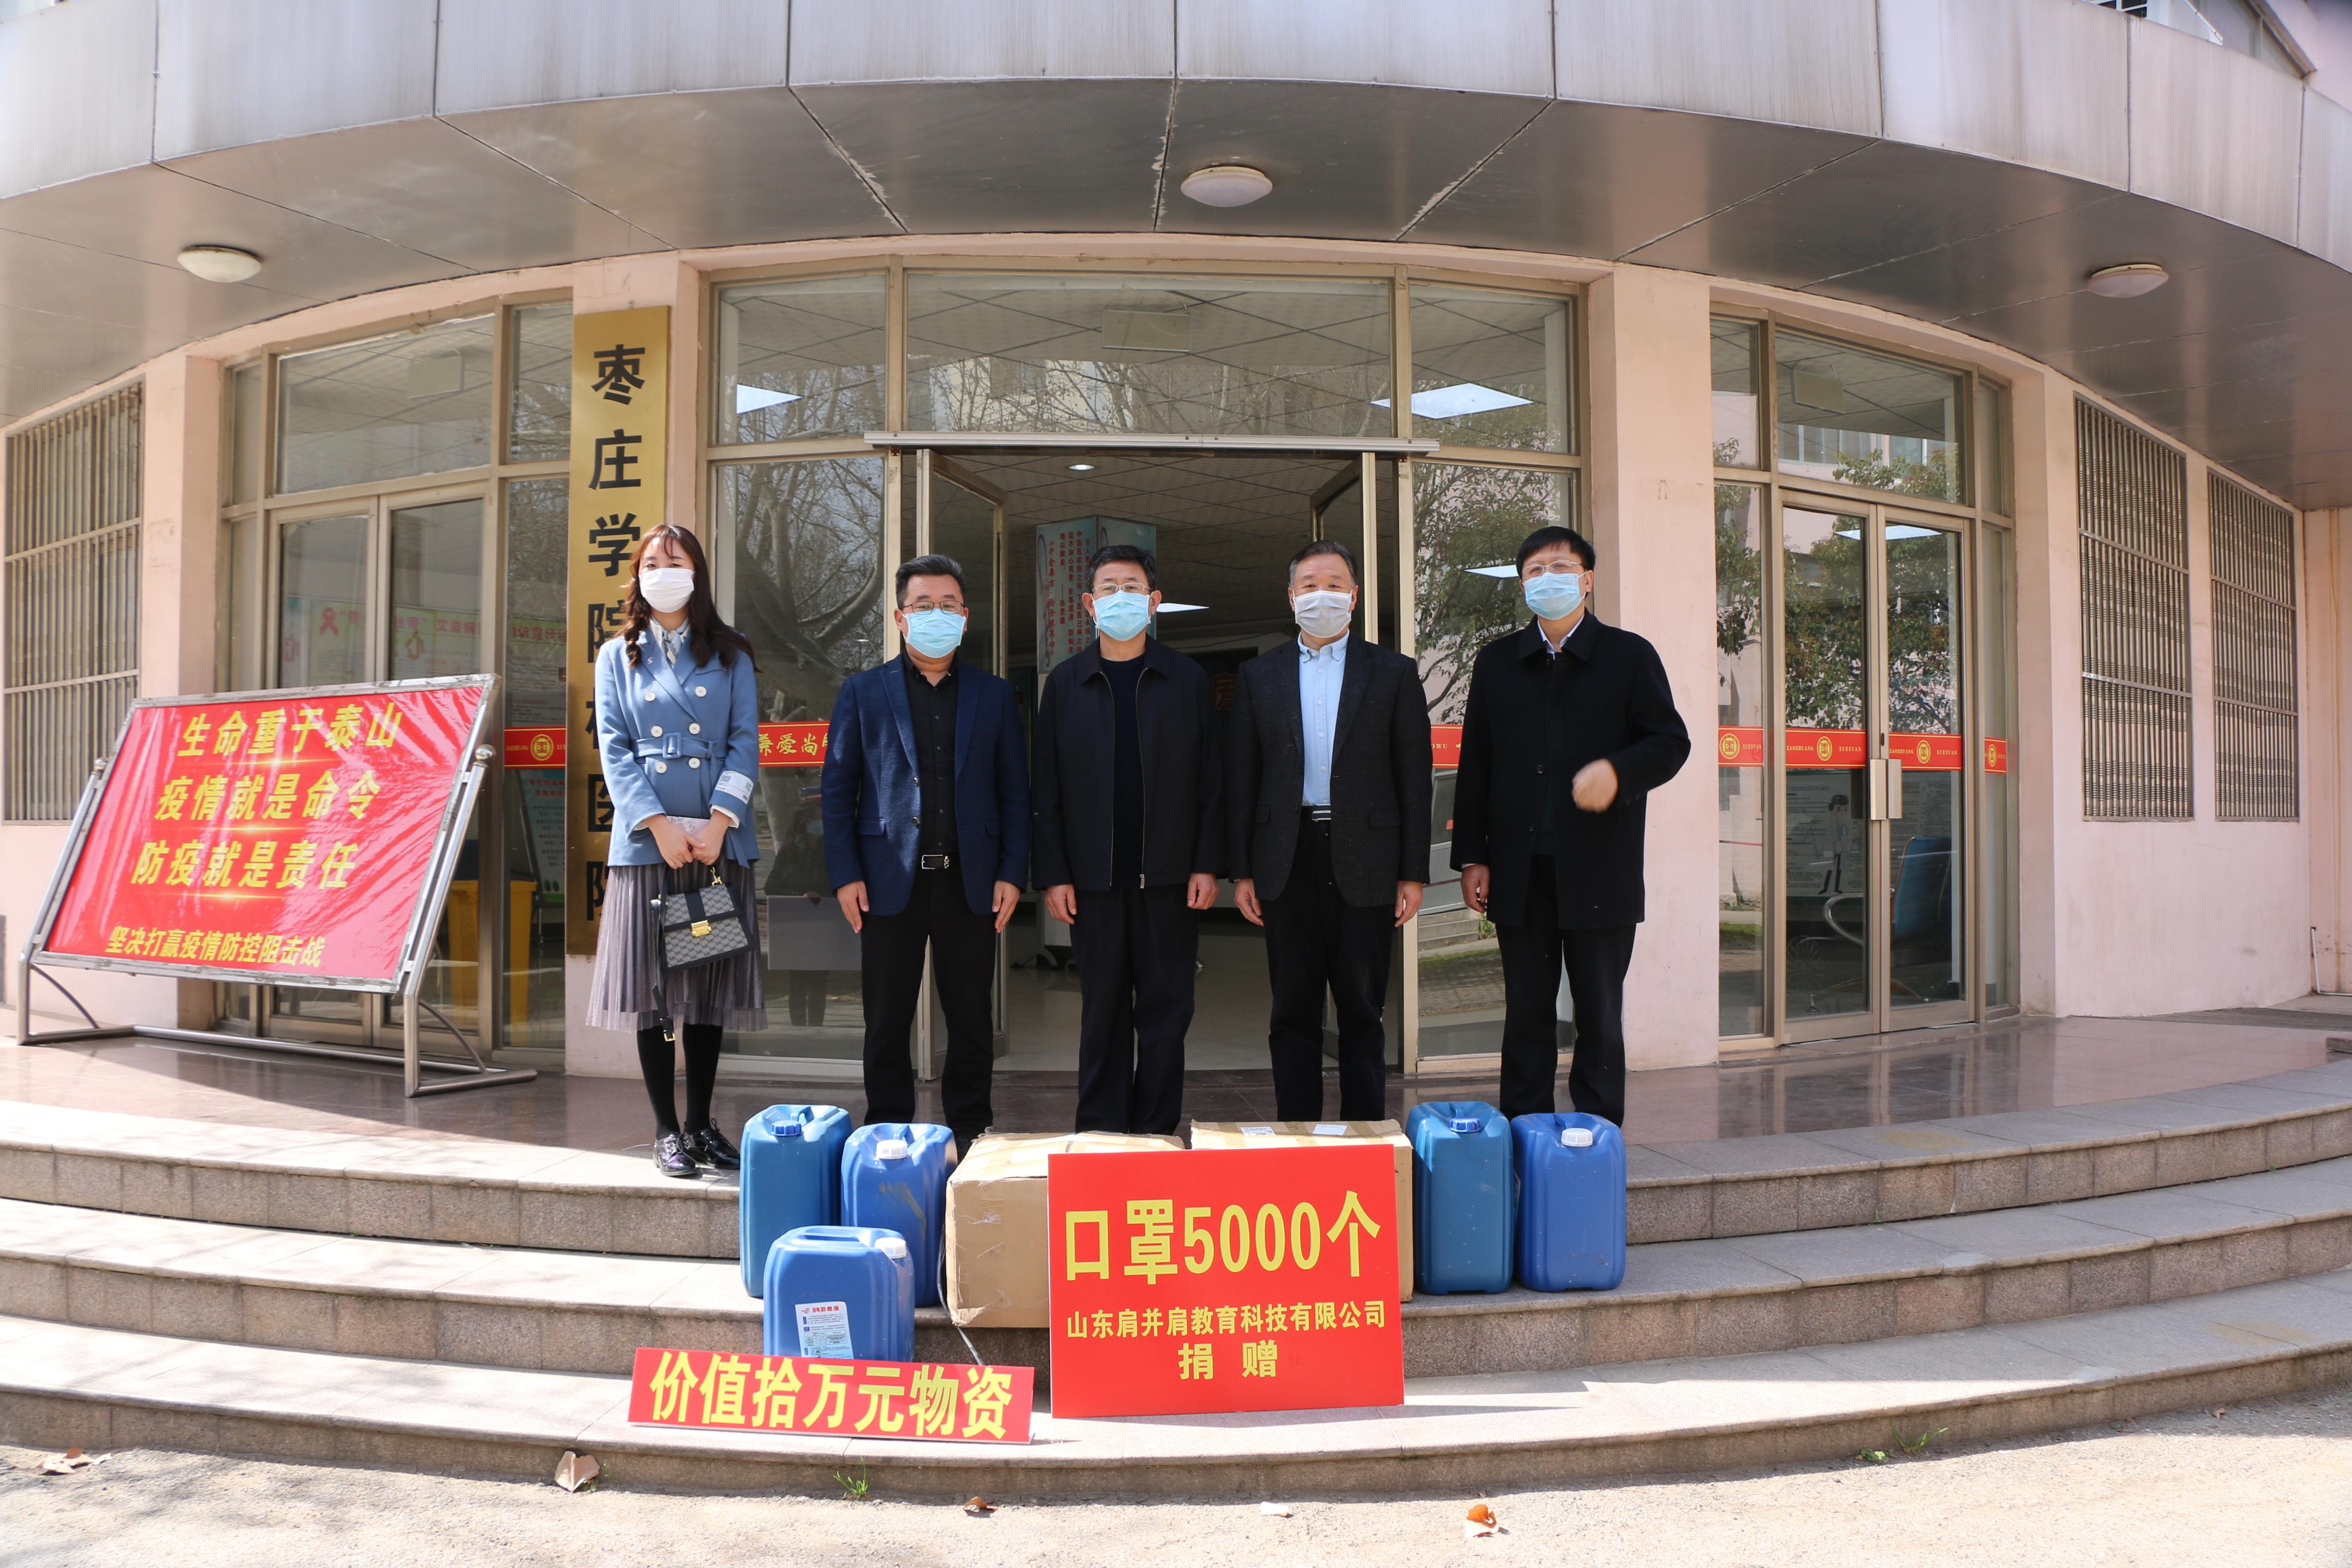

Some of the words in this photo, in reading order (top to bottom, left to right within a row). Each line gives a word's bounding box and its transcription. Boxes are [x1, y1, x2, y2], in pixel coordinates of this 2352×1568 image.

[585, 343, 645, 921] 枣庄学院
[177, 702, 402, 757] 生命重于泰山
[154, 770, 381, 821] 疫情就是命令
[130, 839, 358, 889] 防疫就是责任
[105, 926, 325, 967] 坚决打赢疫情防控阻击战
[1065, 1190, 1381, 1285] 口罩5000个
[1067, 1300, 1385, 1338] 山东肩并肩教育科技有限公司
[649, 1351, 1012, 1439] 价值拾万元物资
